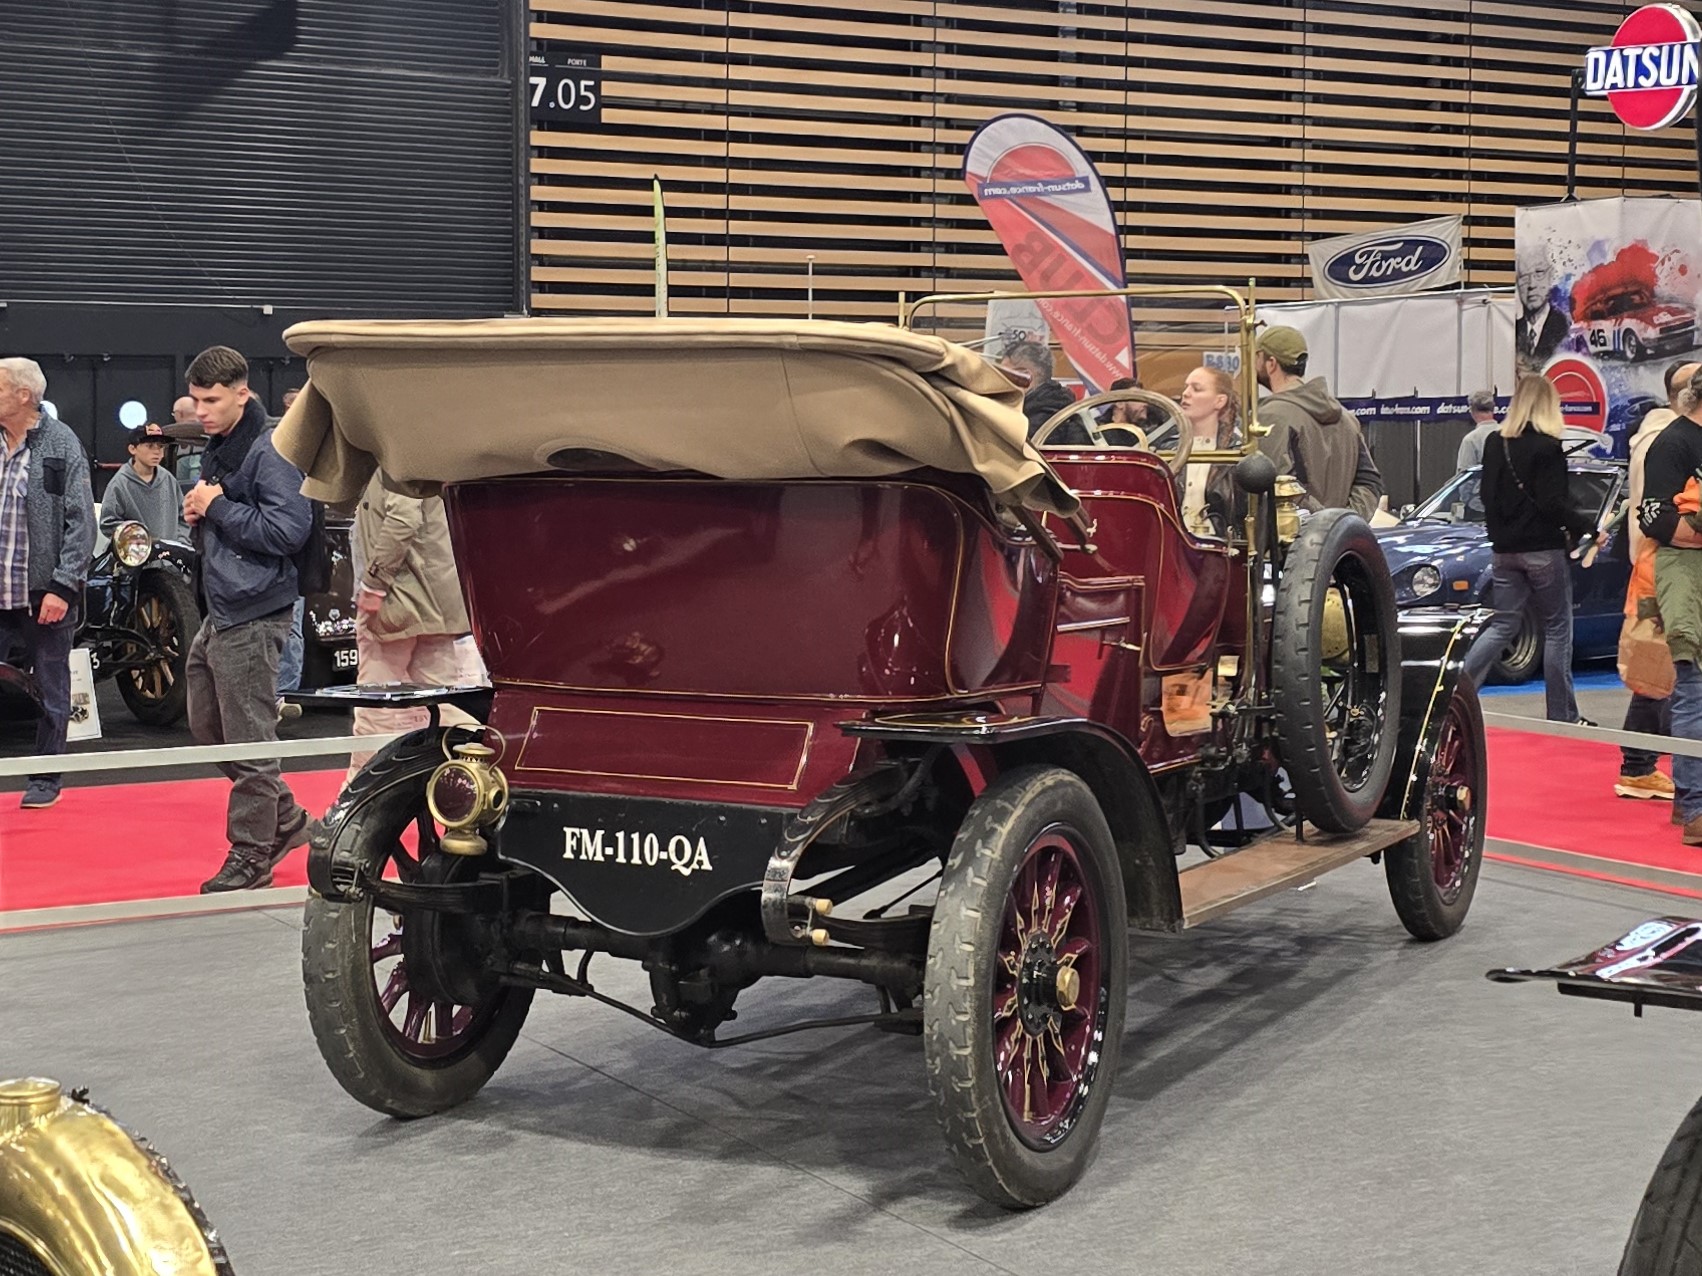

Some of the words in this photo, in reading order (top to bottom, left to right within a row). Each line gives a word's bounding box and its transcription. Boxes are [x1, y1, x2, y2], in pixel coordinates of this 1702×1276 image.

[567, 58, 587, 67] PORTE
[1586, 43, 1699, 91] DATSUN
[529, 76, 596, 111] 7.05
[1349, 242, 1423, 281] Ford
[1590, 329, 1607, 347] 46
[563, 826, 713, 877] FM-110-QA
